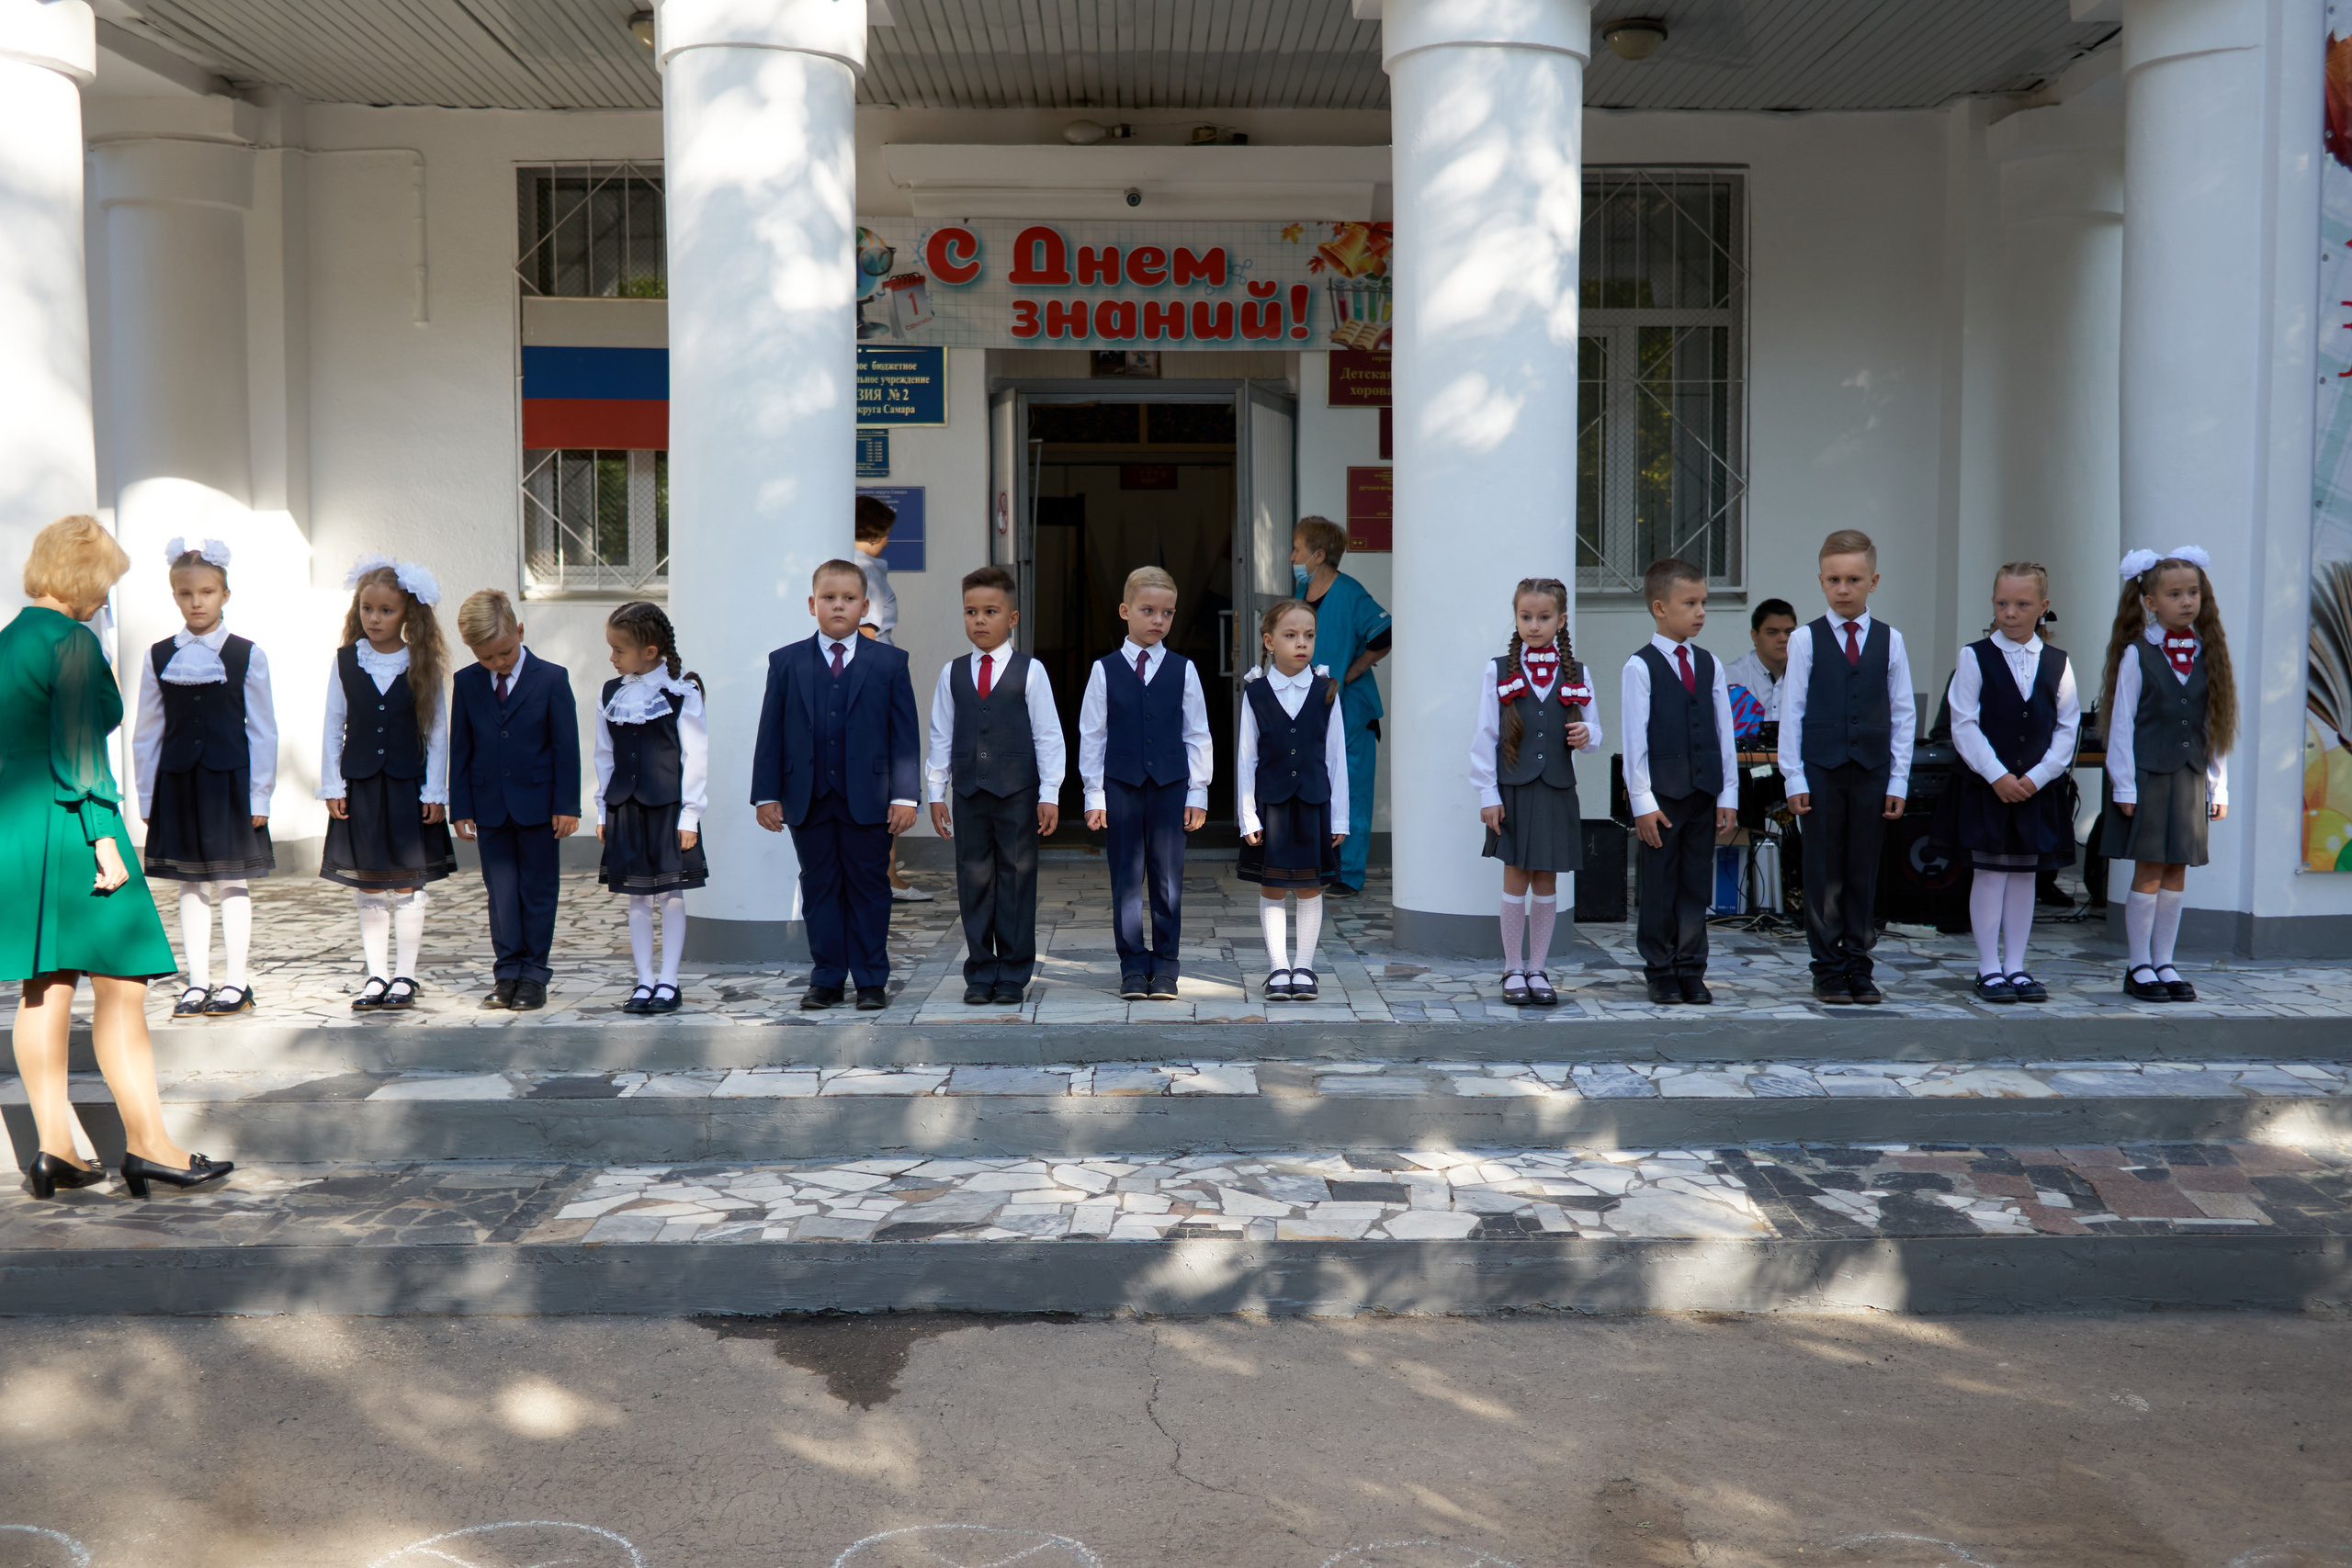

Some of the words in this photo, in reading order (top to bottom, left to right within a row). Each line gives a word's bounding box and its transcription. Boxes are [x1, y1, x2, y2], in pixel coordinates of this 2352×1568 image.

[926, 227, 981, 285] С
[1009, 225, 1227, 287] Днем
[909, 292, 918, 316] 1
[1011, 279, 1310, 341] знаний!
[872, 361, 917, 371] бюджетное
[880, 377, 930, 386] учреждение
[902, 389, 910, 400] 2
[856, 406, 881, 416] круга
[883, 404, 915, 416] Самара
